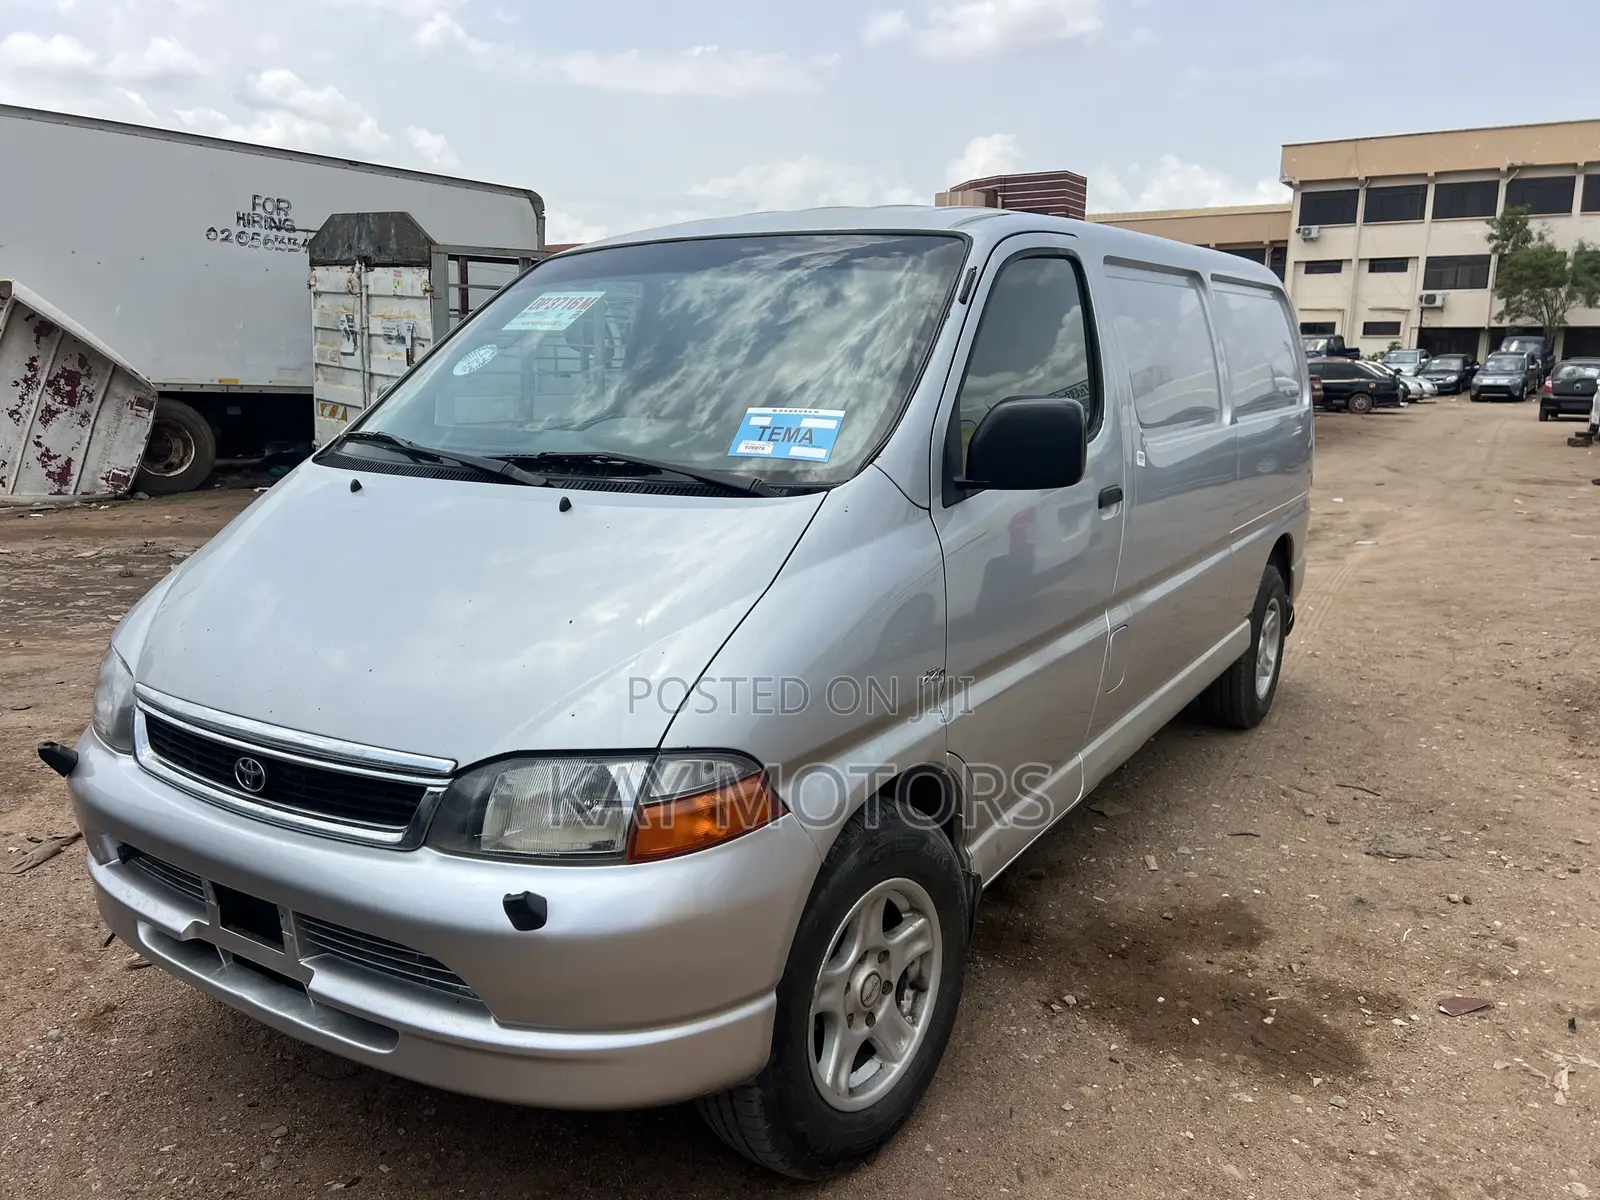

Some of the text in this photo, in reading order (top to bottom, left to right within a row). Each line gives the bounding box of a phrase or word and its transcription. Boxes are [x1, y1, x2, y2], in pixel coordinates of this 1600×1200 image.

[251, 194, 292, 216] FOR
[236, 211, 296, 233] HIRING
[527, 296, 599, 311] DP3716M
[758, 425, 814, 445] TEMA
